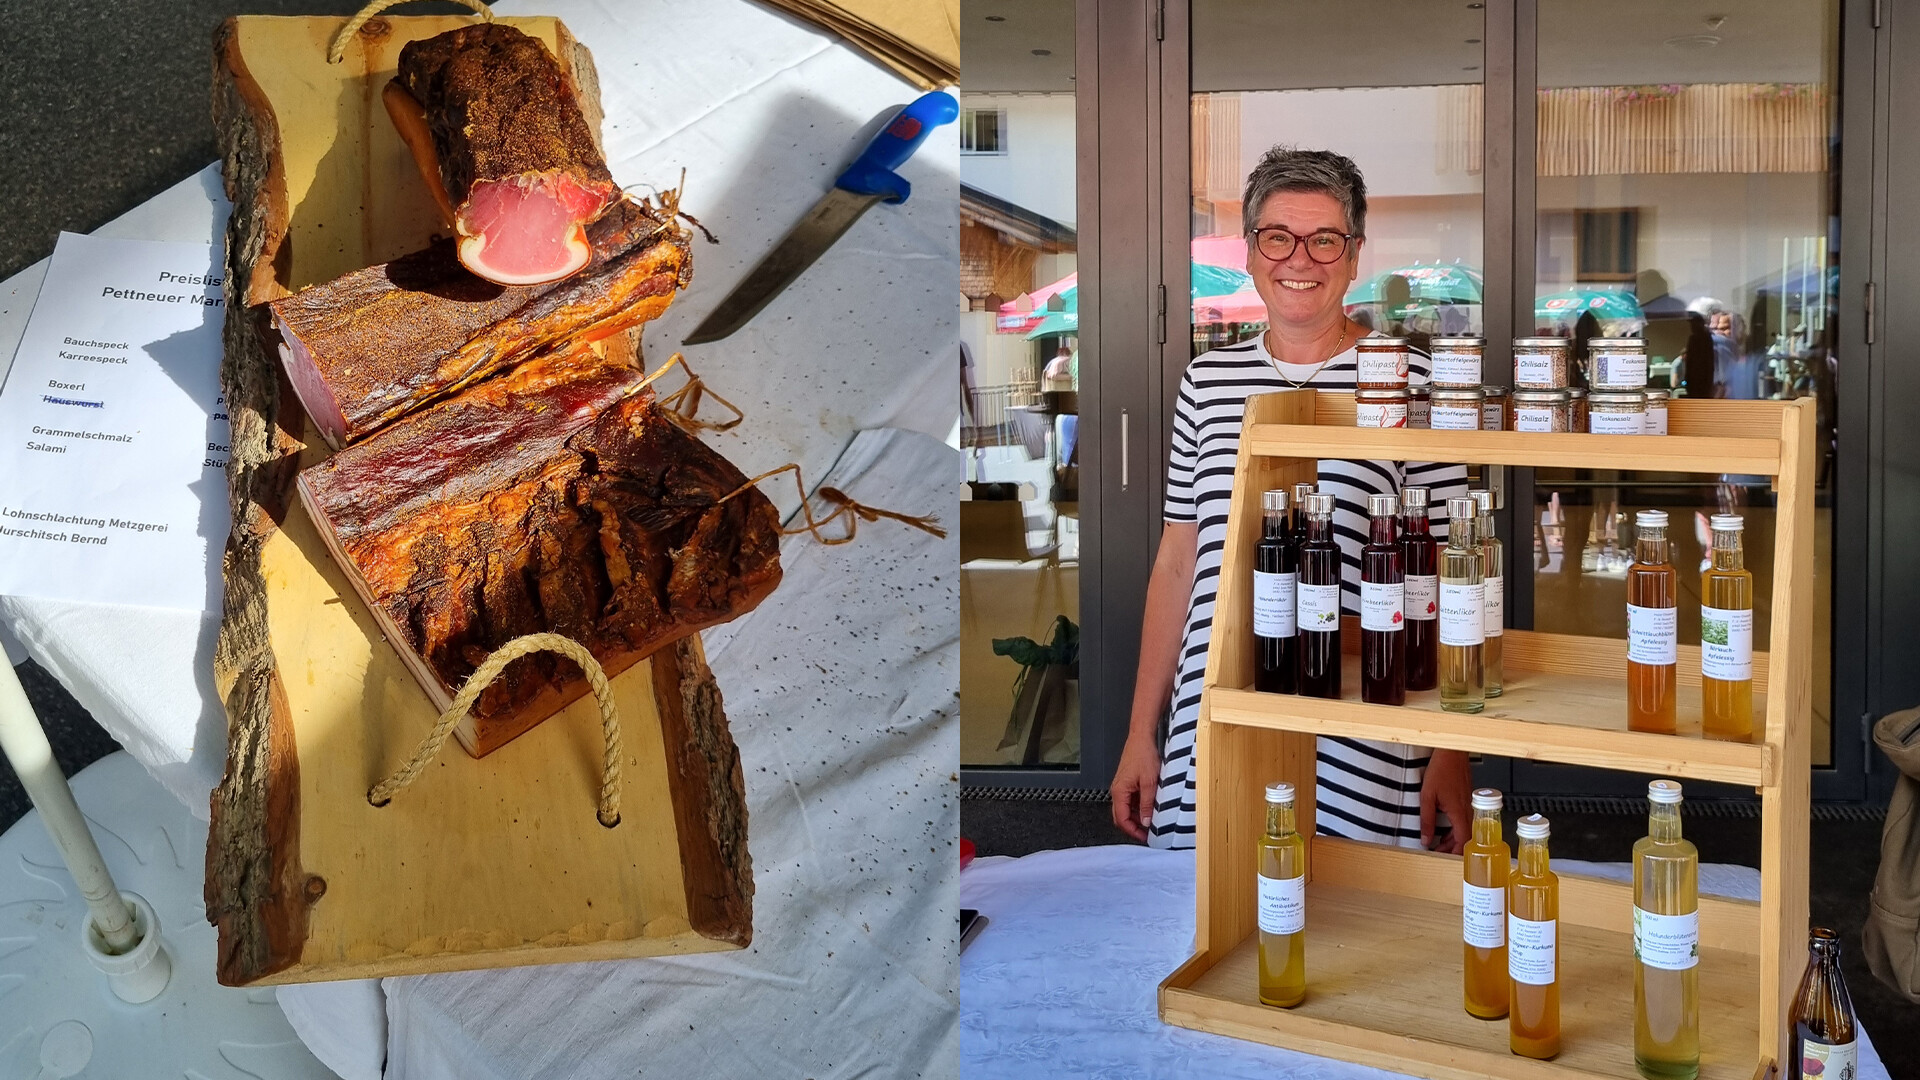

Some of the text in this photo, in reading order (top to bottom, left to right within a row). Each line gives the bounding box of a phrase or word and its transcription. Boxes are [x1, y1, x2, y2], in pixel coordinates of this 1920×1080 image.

[159, 271, 225, 287] Preislis
[102, 286, 186, 303] Pettneuer
[63, 336, 129, 350] Bauchspeck
[58, 350, 128, 364] Karreespeck
[1520, 360, 1549, 368] Chilisalz
[48, 379, 85, 391] Boxerl
[43, 394, 105, 409] Hauswurst
[1520, 414, 1549, 422] Chilisalz
[32, 425, 133, 443] Grammelschmalz
[26, 441, 67, 454] Salami
[207, 442, 230, 452] Bec
[2, 506, 169, 533] Lohnschlachtung Metzgerei
[70, 533, 108, 545] Bernd
